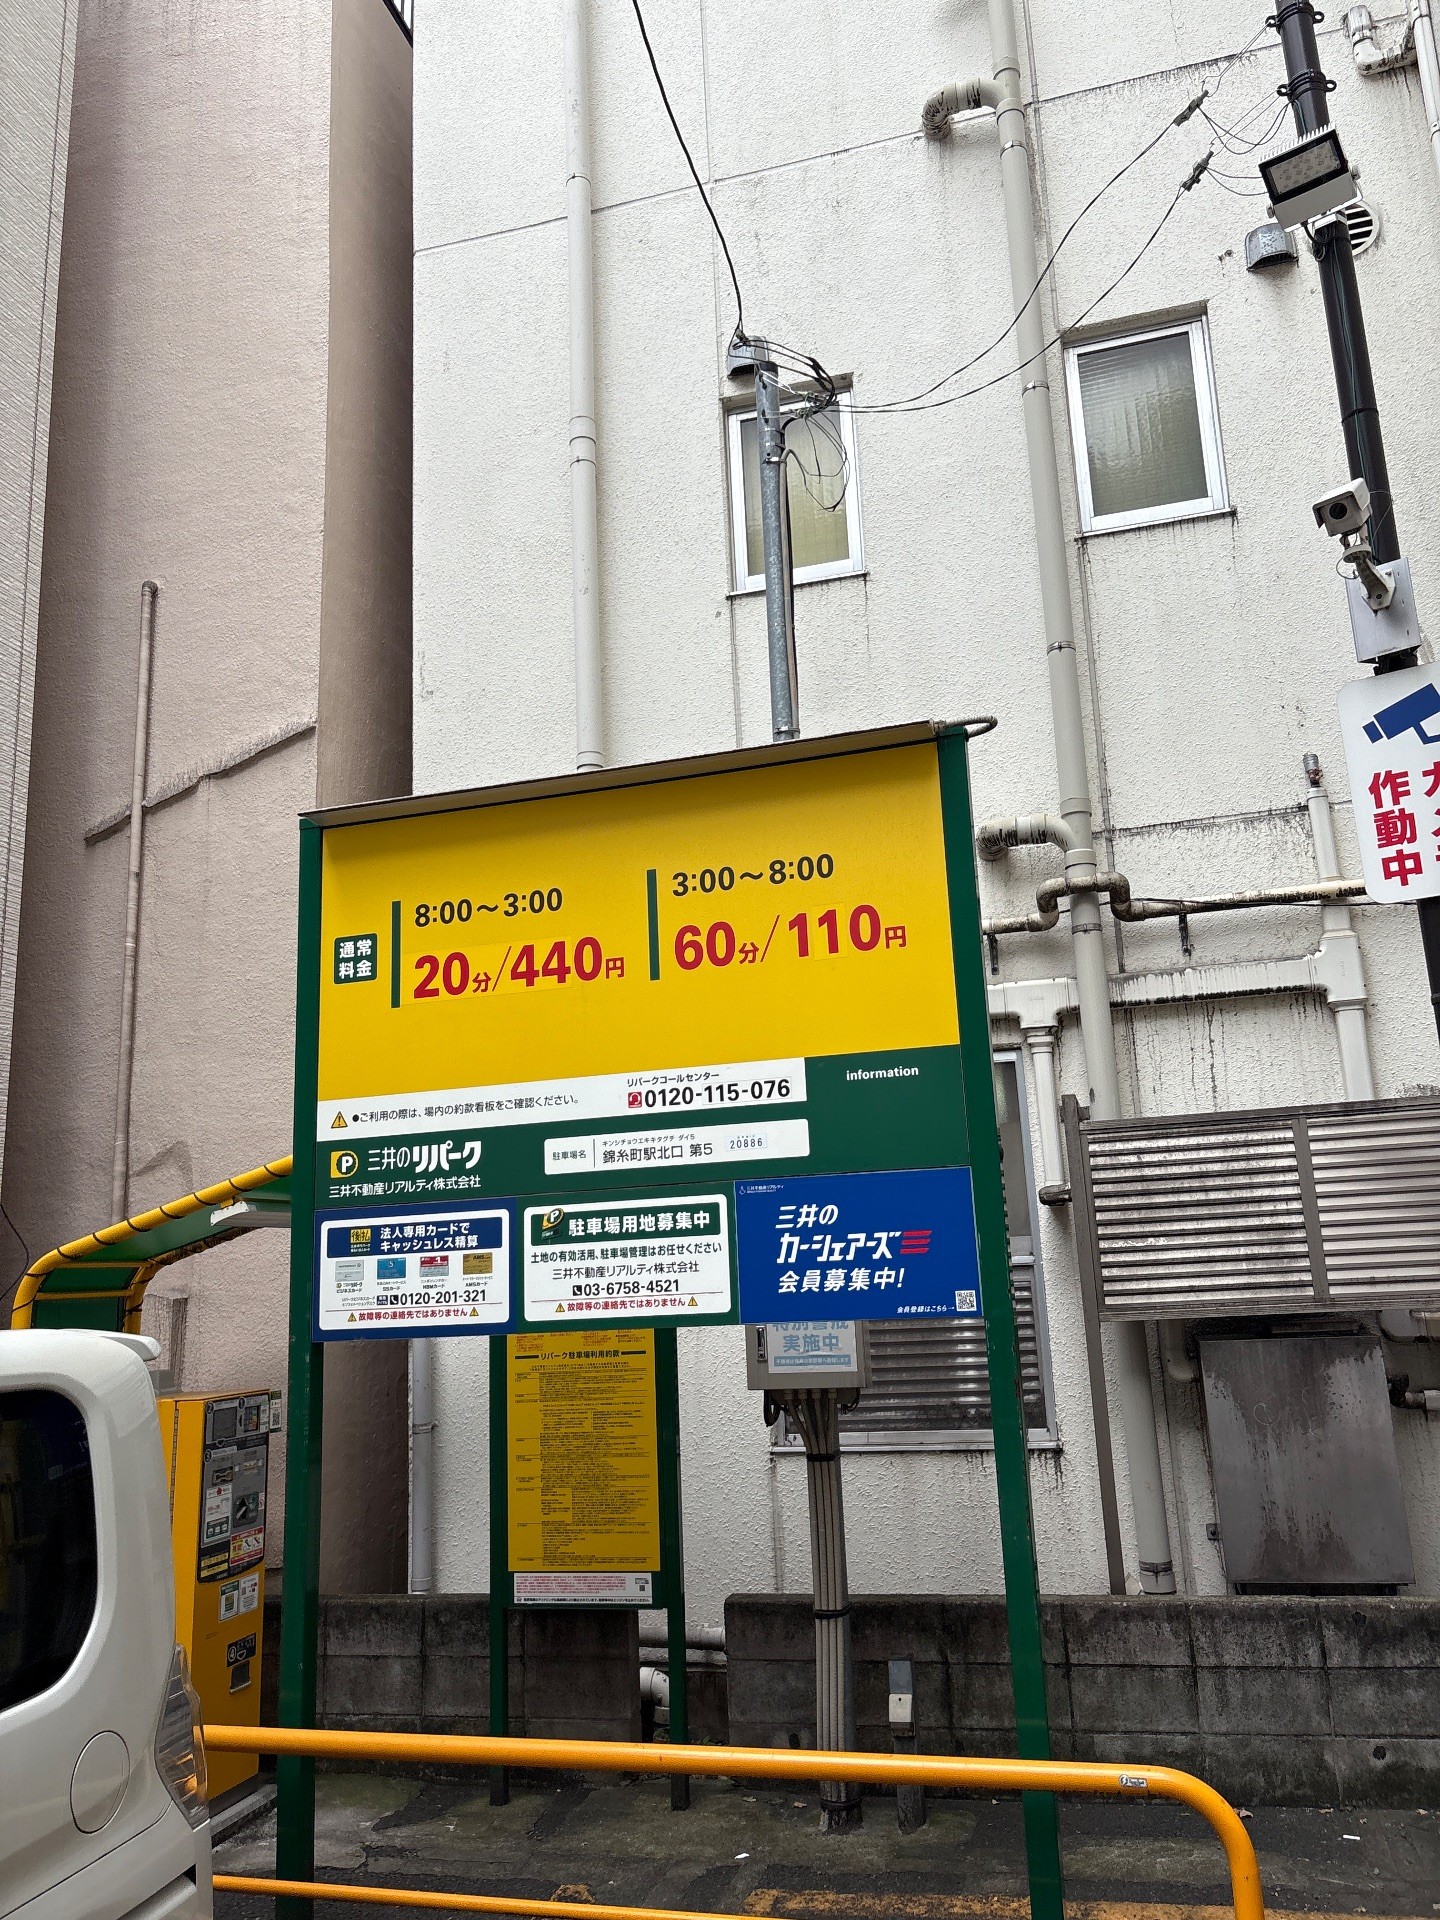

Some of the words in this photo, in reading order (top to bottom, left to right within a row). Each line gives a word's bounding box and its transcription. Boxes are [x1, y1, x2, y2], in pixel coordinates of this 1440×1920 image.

[1368, 770, 1423, 886] 作動中
[339, 938, 372, 959] 通常
[338, 959, 372, 979] 料金
[627, 1072, 719, 1087] リパークコールセンター
[846, 1066, 919, 1081] information
[645, 1079, 790, 1108] 0120-115-076
[602, 1144, 683, 1164] 錦糸町駅北口
[690, 1142, 713, 1157] 第5
[730, 1137, 763, 1150] 20886
[368, 1140, 482, 1174] 三井のリパーク
[552, 1149, 587, 1161] 駐車場名
[329, 1174, 481, 1199] 三井不動産リアルティ株式会社
[569, 1210, 710, 1237] 駐車場用地募集中
[775, 1203, 838, 1229] 三井の
[351, 1229, 370, 1242] 後払
[380, 1222, 470, 1240] 法人専用カードで
[380, 1235, 478, 1252] キャッシュレス精算
[531, 1242, 722, 1263] 土地の有効活用、駐車場管理はお任せください
[776, 1231, 902, 1263] カーシェアーズ
[552, 1260, 699, 1280] 三井不動産リアルティ株式会社
[400, 1289, 486, 1306] 0120-201-321
[584, 1279, 680, 1296] 03-6758-4521
[358, 1308, 468, 1321] 故障等の連絡先ではありません
[567, 1298, 685, 1312] 故障等の連絡先ではありません
[783, 1333, 840, 1353] 実施中
[541, 1349, 620, 1360] リパーク駐車場利用約款
